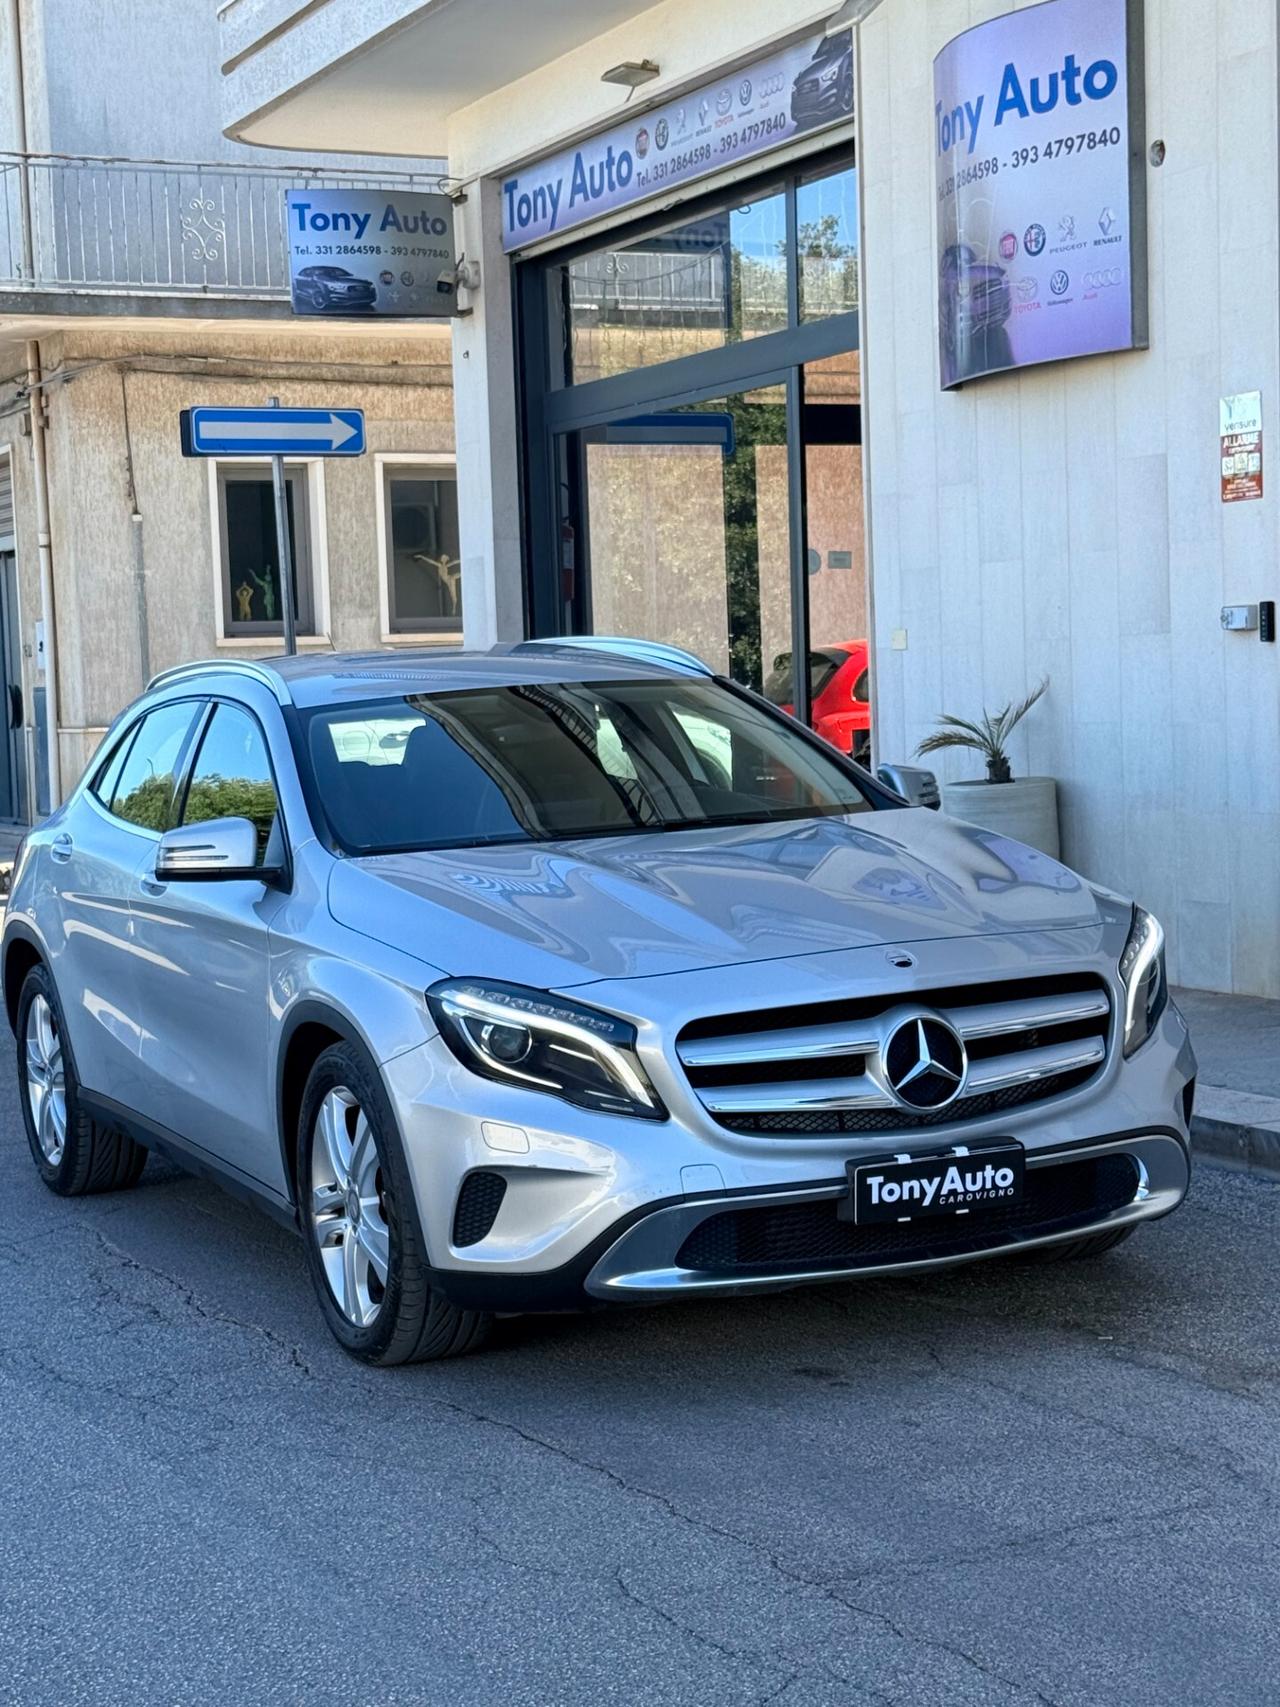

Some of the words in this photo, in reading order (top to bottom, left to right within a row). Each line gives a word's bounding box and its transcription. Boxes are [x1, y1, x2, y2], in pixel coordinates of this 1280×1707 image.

[935, 95, 984, 157] Tony
[994, 54, 1118, 127] Auto
[636, 171, 651, 188] Tel.
[653, 161, 669, 181] 331
[670, 144, 711, 174] 2864598
[719, 132, 739, 153] 393
[740, 112, 786, 144] 4797840
[1012, 146, 1039, 168] 393
[1043, 126, 1121, 159] 4797840
[504, 179, 563, 232] Tony
[569, 145, 633, 208] Auto
[292, 203, 371, 239] Tony
[379, 204, 448, 235] Auto
[1049, 241, 1088, 254] PEUGEOT
[1093, 235, 1122, 247] RENAULT
[294, 246, 312, 255] Tel.
[315, 246, 332, 255] 331
[336, 245, 381, 256] 2864598
[391, 246, 408, 256] 393
[411, 248, 449, 259] 4797840
[1014, 301, 1042, 314] TOYOTA
[1224, 418, 1257, 431] verisure
[939, 1187, 1015, 1205] CAROVIGNO
